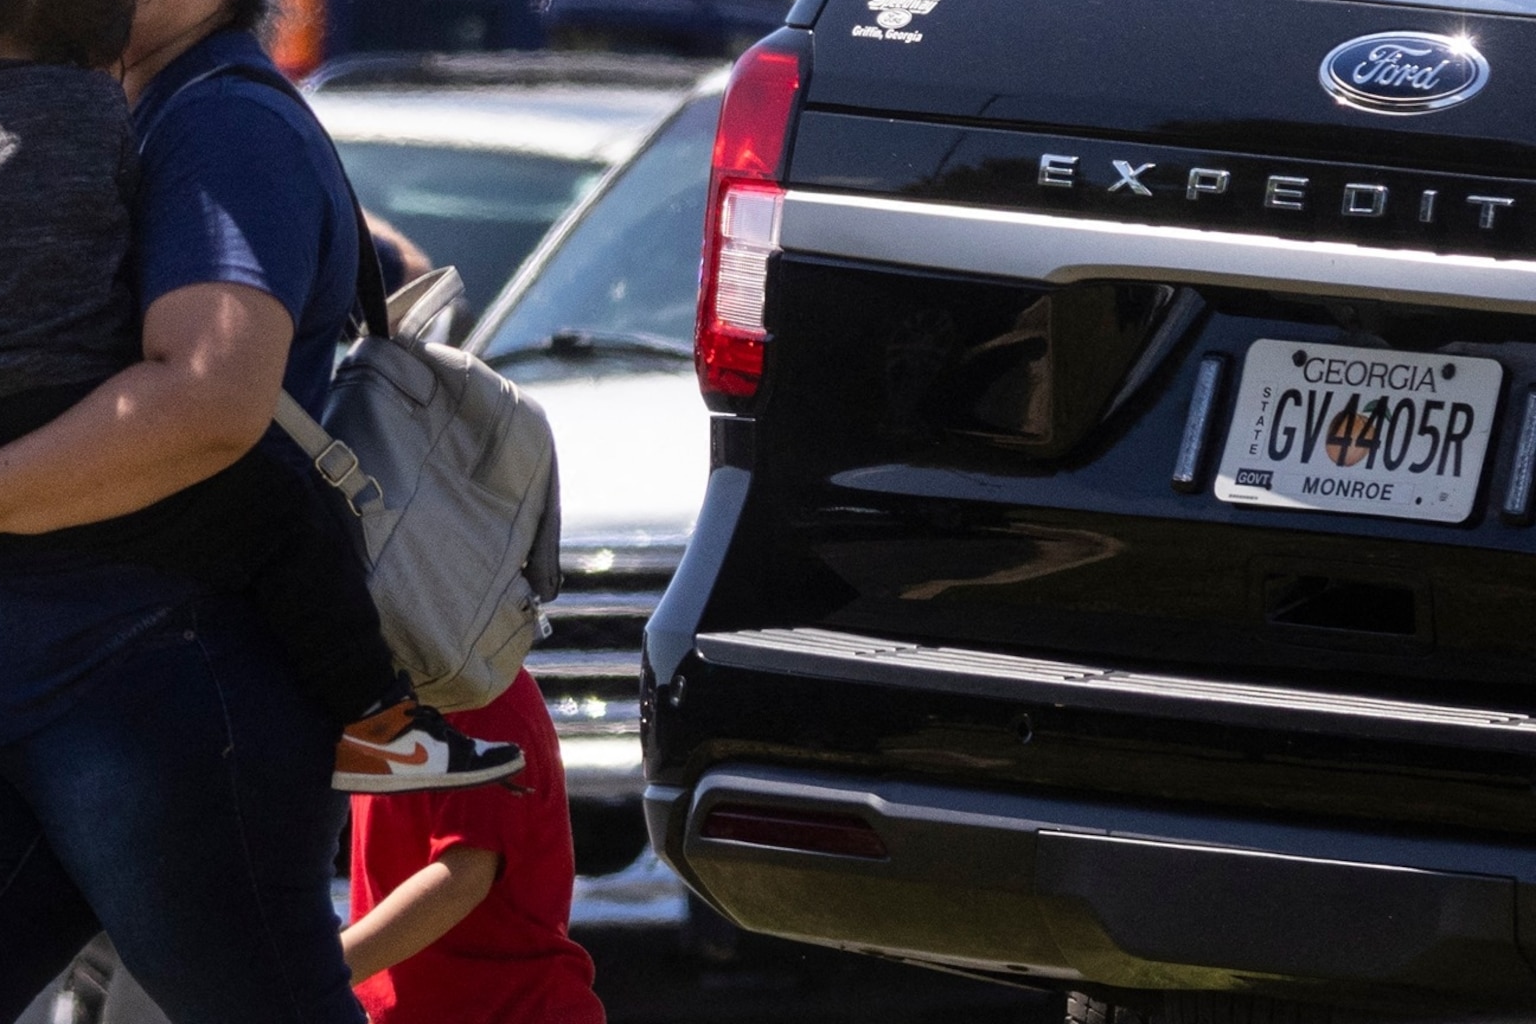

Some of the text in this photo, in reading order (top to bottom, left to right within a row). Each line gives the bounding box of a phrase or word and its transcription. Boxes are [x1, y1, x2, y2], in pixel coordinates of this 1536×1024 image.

[852, 26, 923, 43] Griffin, Georgia
[1352, 44, 1449, 91] Ford
[1303, 356, 1437, 394] GEORGIA
[1248, 386, 1272, 456] STATE
[1268, 388, 1475, 478] GV4405R
[1238, 471, 1270, 486] GOVT
[1302, 476, 1394, 502] MONROE
